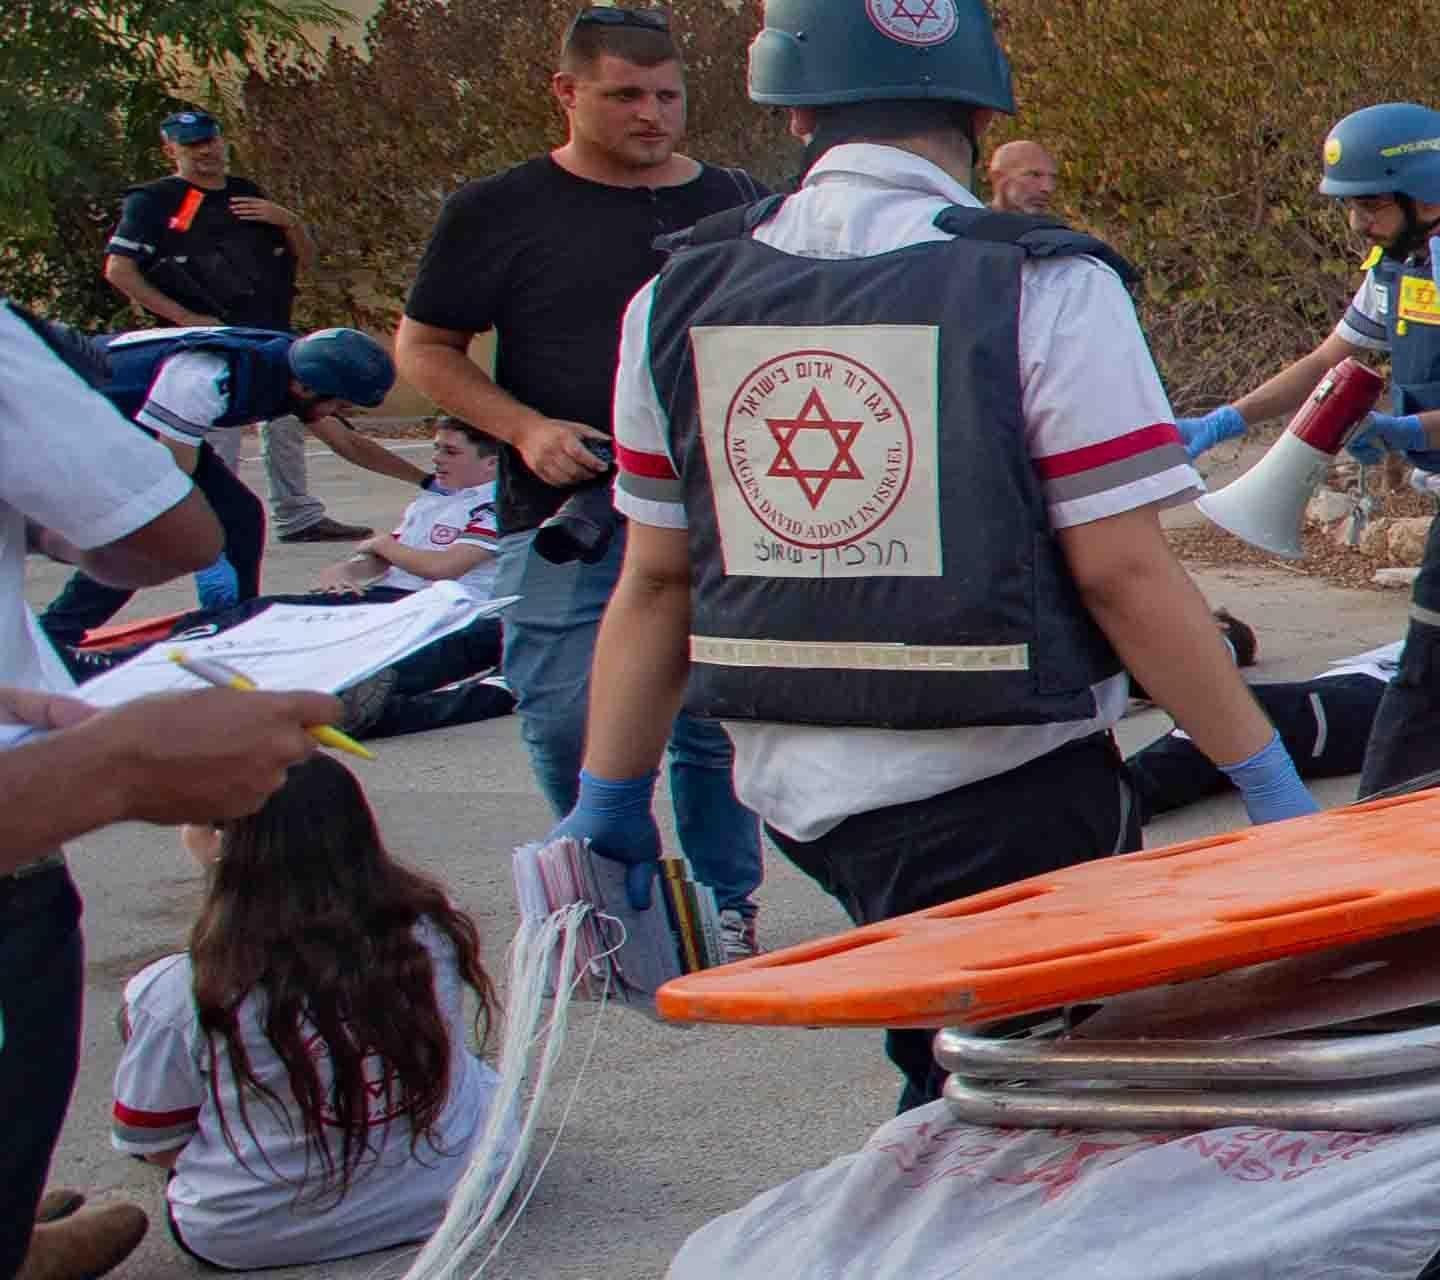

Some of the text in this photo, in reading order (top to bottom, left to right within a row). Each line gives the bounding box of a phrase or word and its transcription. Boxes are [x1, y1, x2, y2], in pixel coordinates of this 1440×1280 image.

[737, 361, 894, 423] מגן דוד אדום בישראל
[732, 438, 904, 540] MAGEN DAVID ADOM IN ISRAEL
